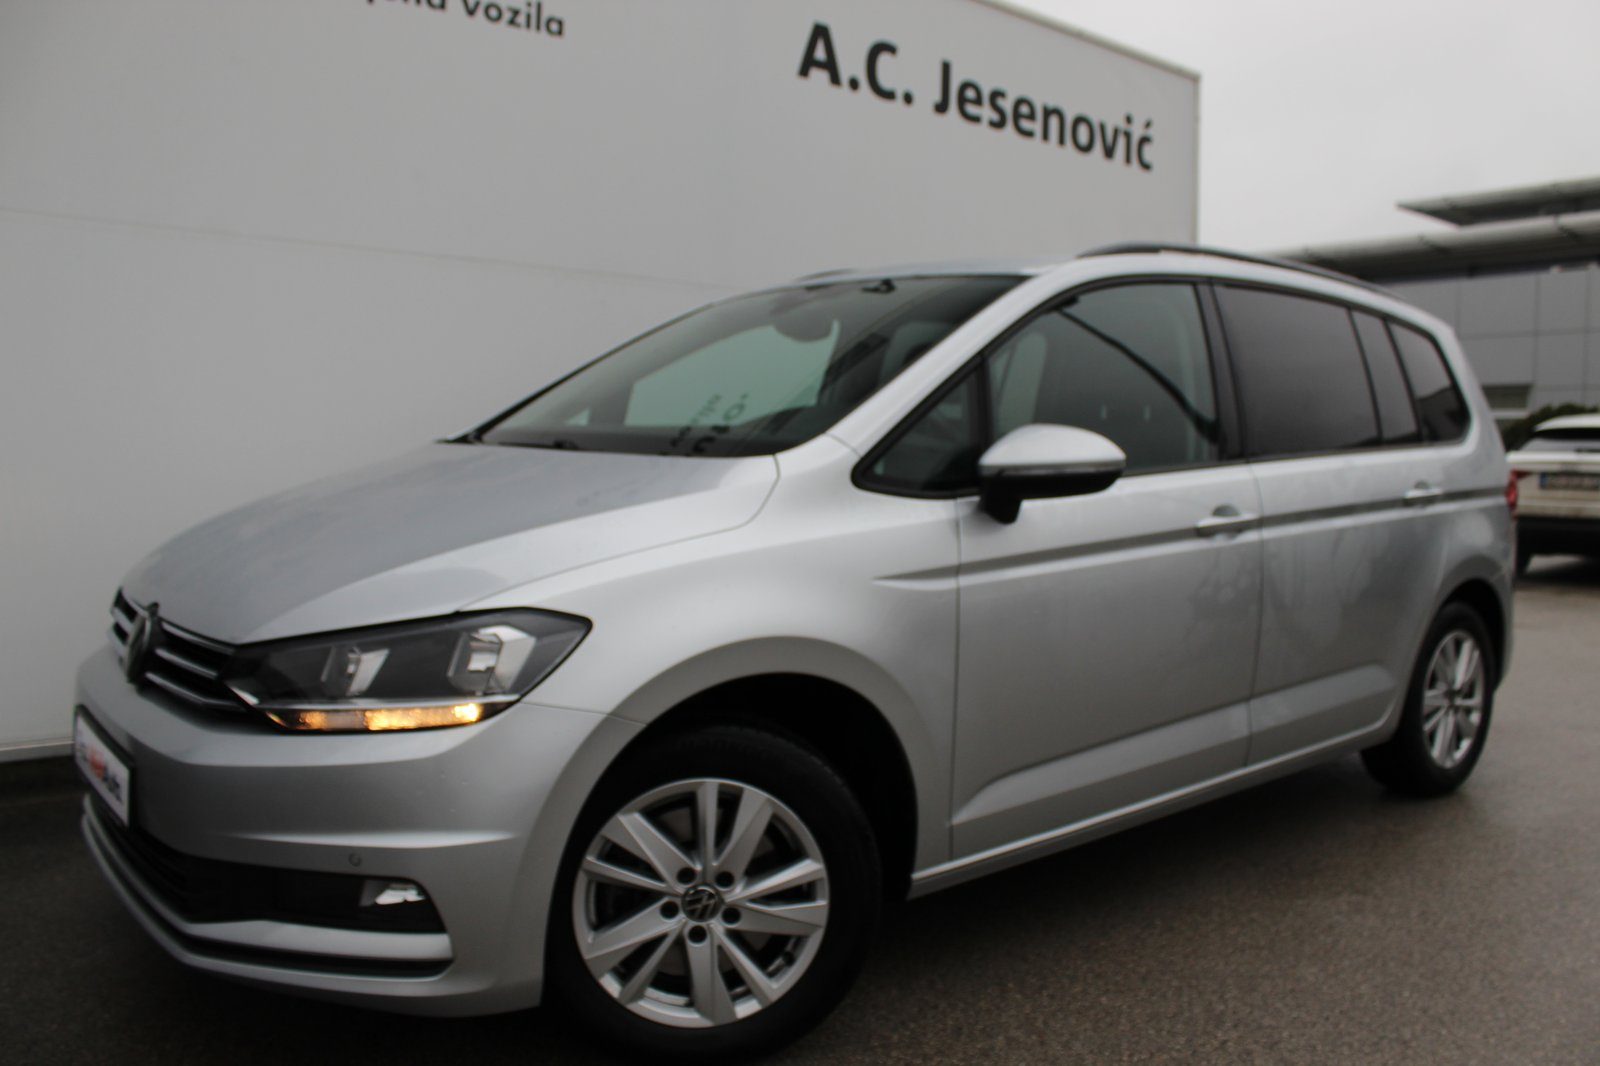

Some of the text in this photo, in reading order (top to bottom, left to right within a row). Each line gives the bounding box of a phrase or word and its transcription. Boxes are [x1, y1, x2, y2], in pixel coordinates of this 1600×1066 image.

[462, 0, 565, 38] vozila
[797, 21, 1154, 172] A.C. Jesenović
